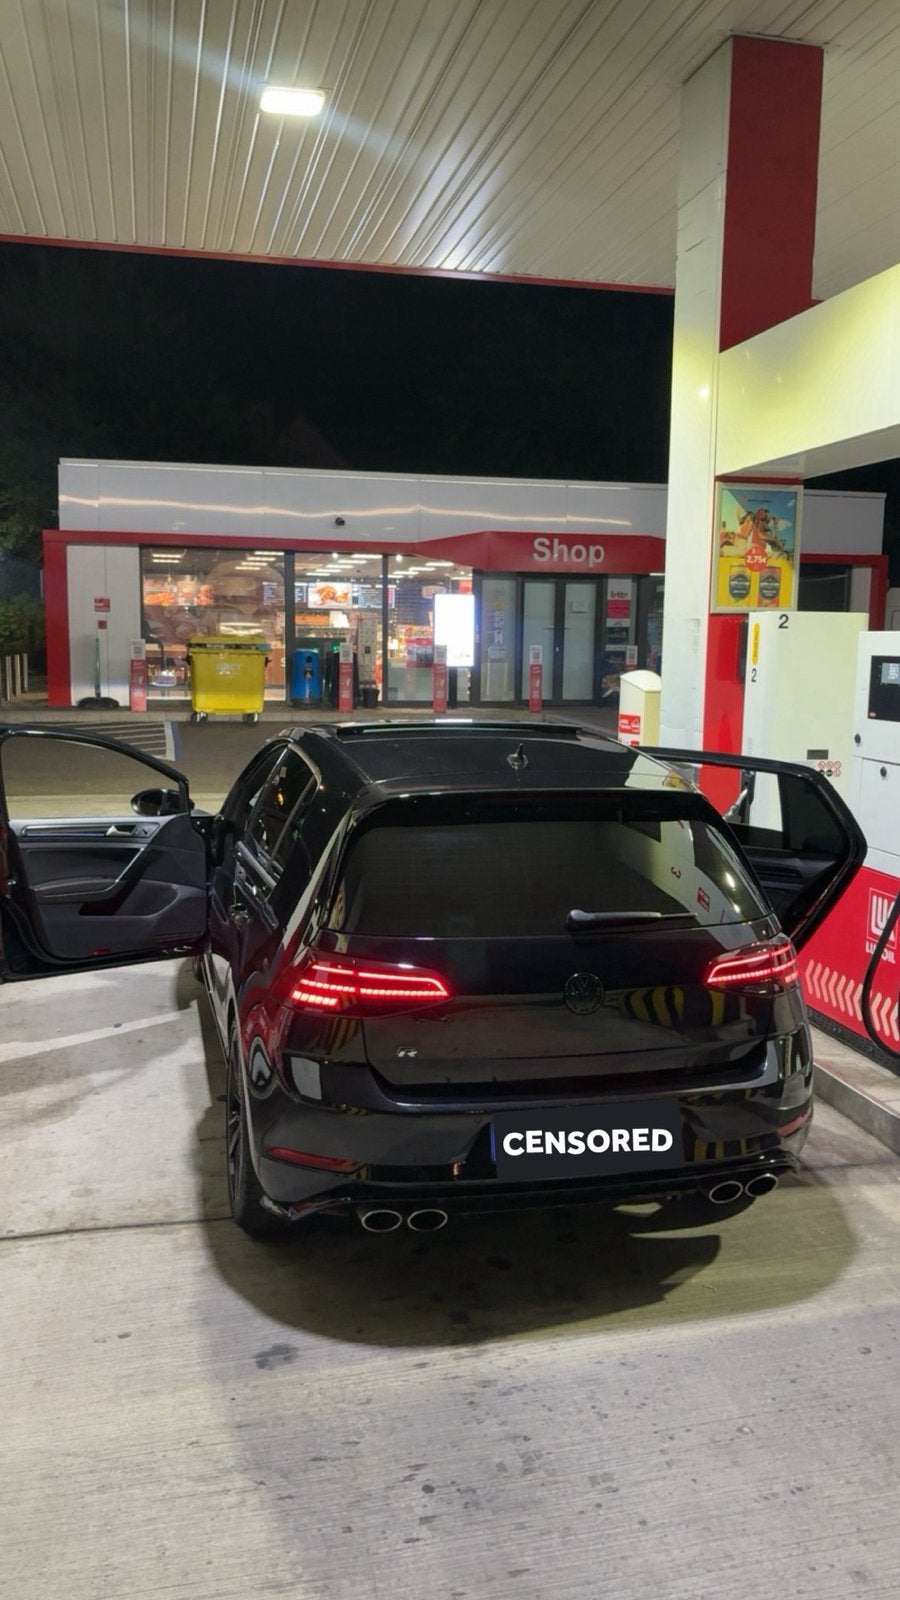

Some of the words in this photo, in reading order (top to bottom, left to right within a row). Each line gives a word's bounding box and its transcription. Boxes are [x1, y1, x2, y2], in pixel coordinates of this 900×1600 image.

[533, 537, 605, 568] Shop
[778, 613, 790, 629] 2
[750, 667, 758, 683] 2
[865, 941, 897, 965] LUOIL
